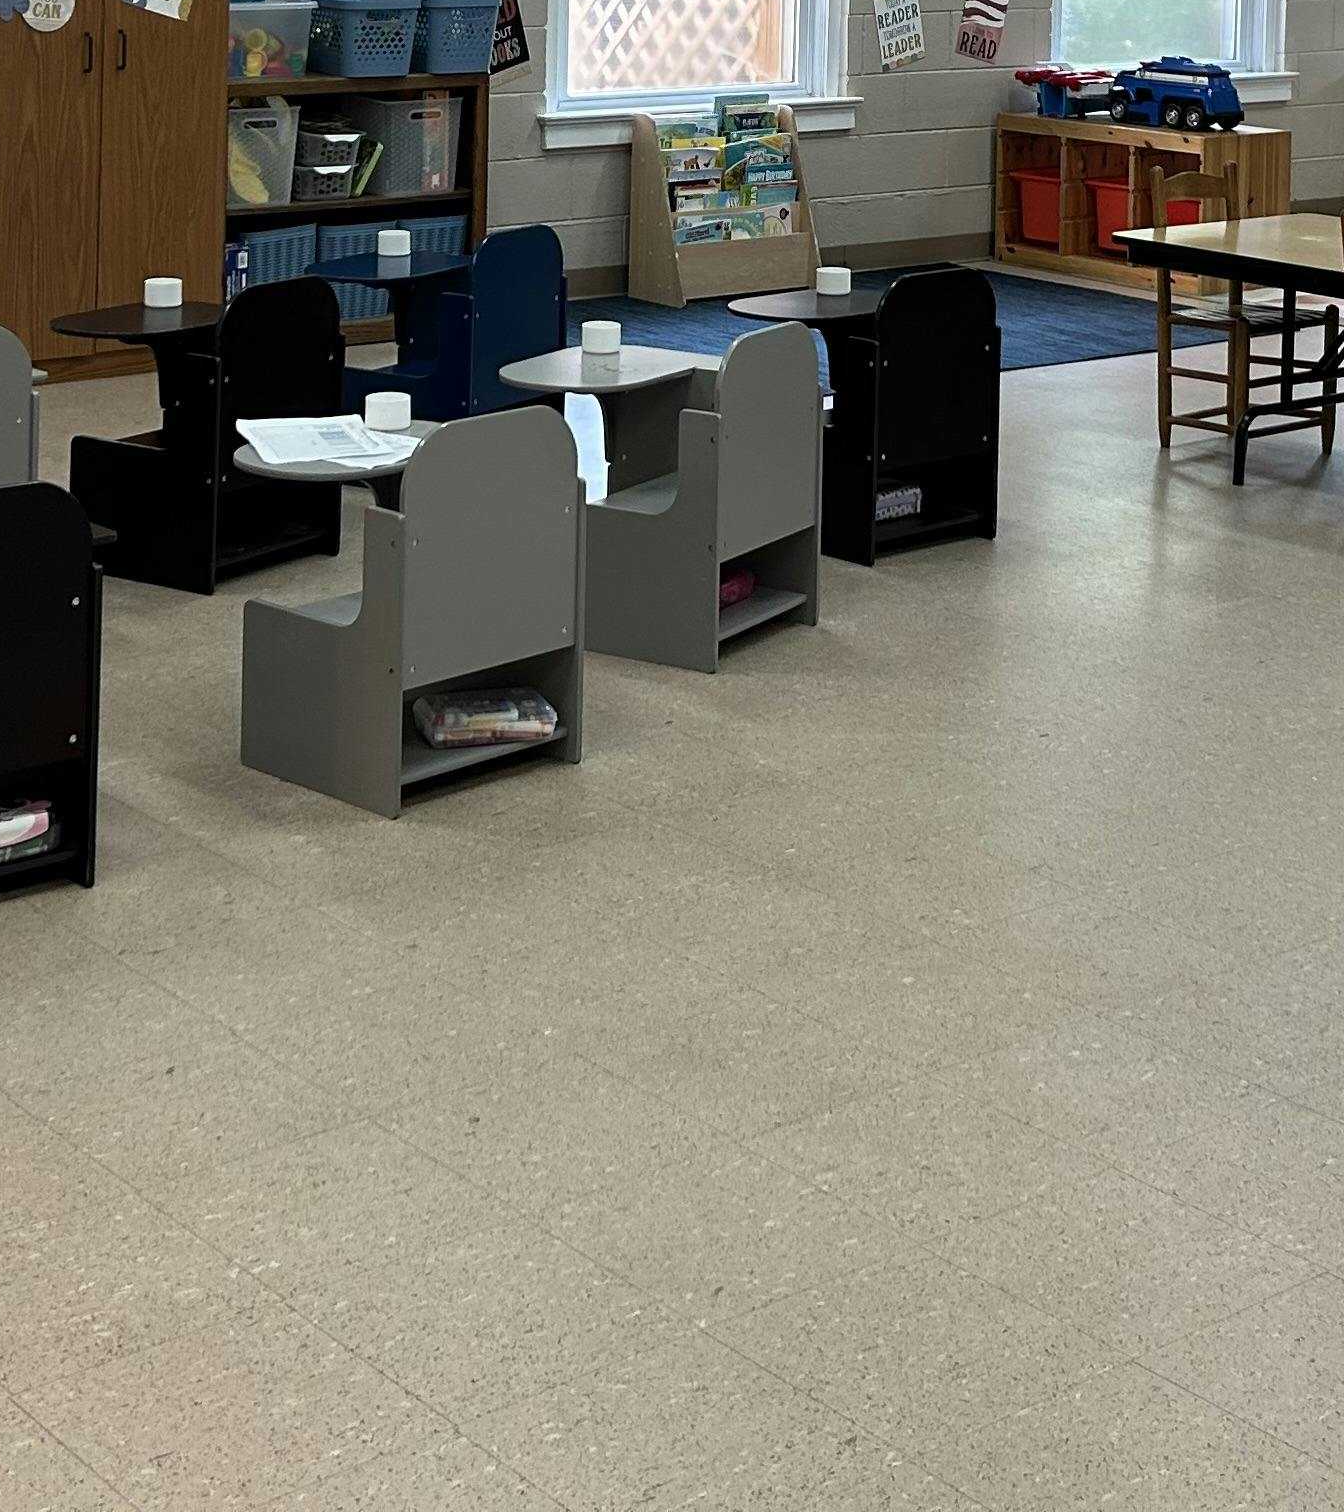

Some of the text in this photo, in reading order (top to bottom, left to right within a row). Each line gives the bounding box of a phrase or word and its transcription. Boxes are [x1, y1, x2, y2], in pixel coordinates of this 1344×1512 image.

[32, 2, 62, 19] CAN
[877, 3, 919, 30] READER
[494, 25, 513, 41] OUT
[911, 23, 917, 32] A
[490, 37, 521, 67] OOKS
[882, 33, 922, 60] LEADER
[959, 30, 997, 60] READ
